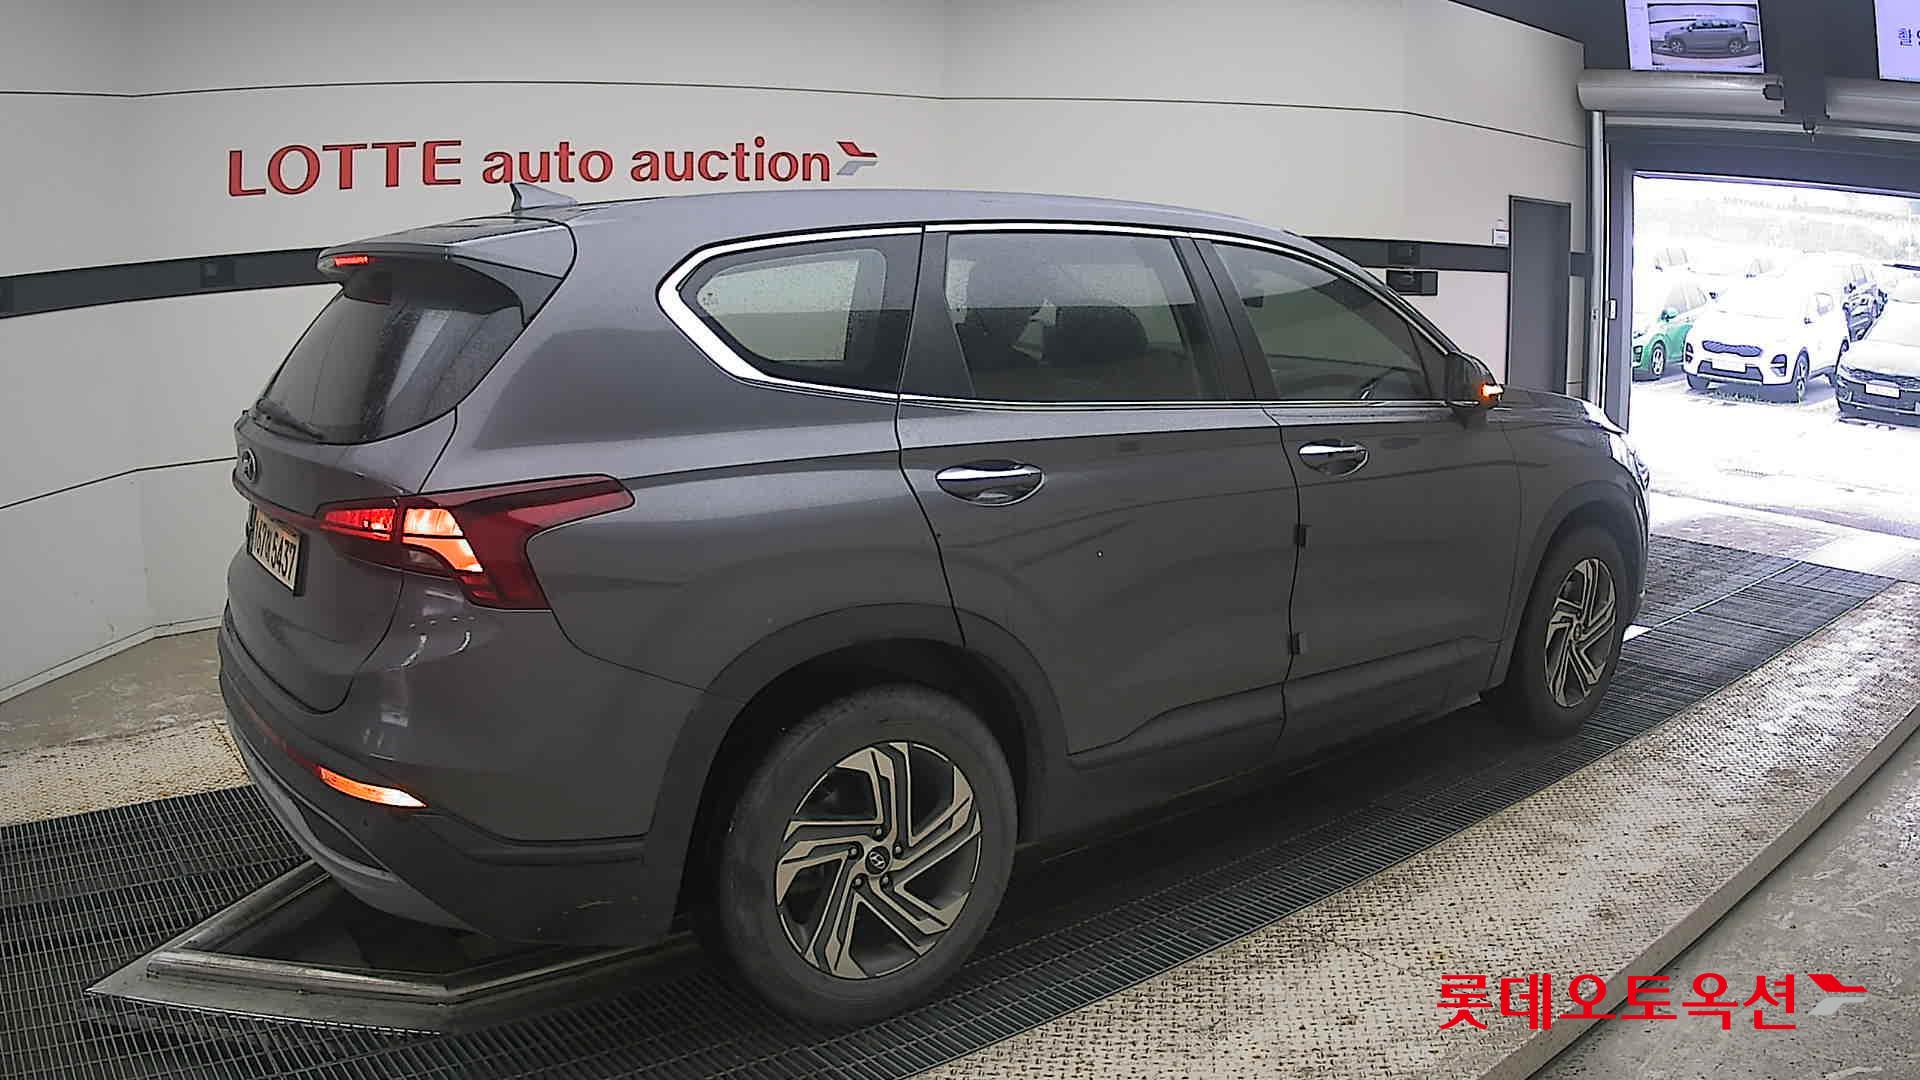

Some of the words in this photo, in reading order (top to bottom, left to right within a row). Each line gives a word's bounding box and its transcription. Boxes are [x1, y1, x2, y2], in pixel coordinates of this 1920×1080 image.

[228, 140, 462, 197] LOTTE
[482, 141, 614, 184] auto
[630, 136, 831, 182] auction
